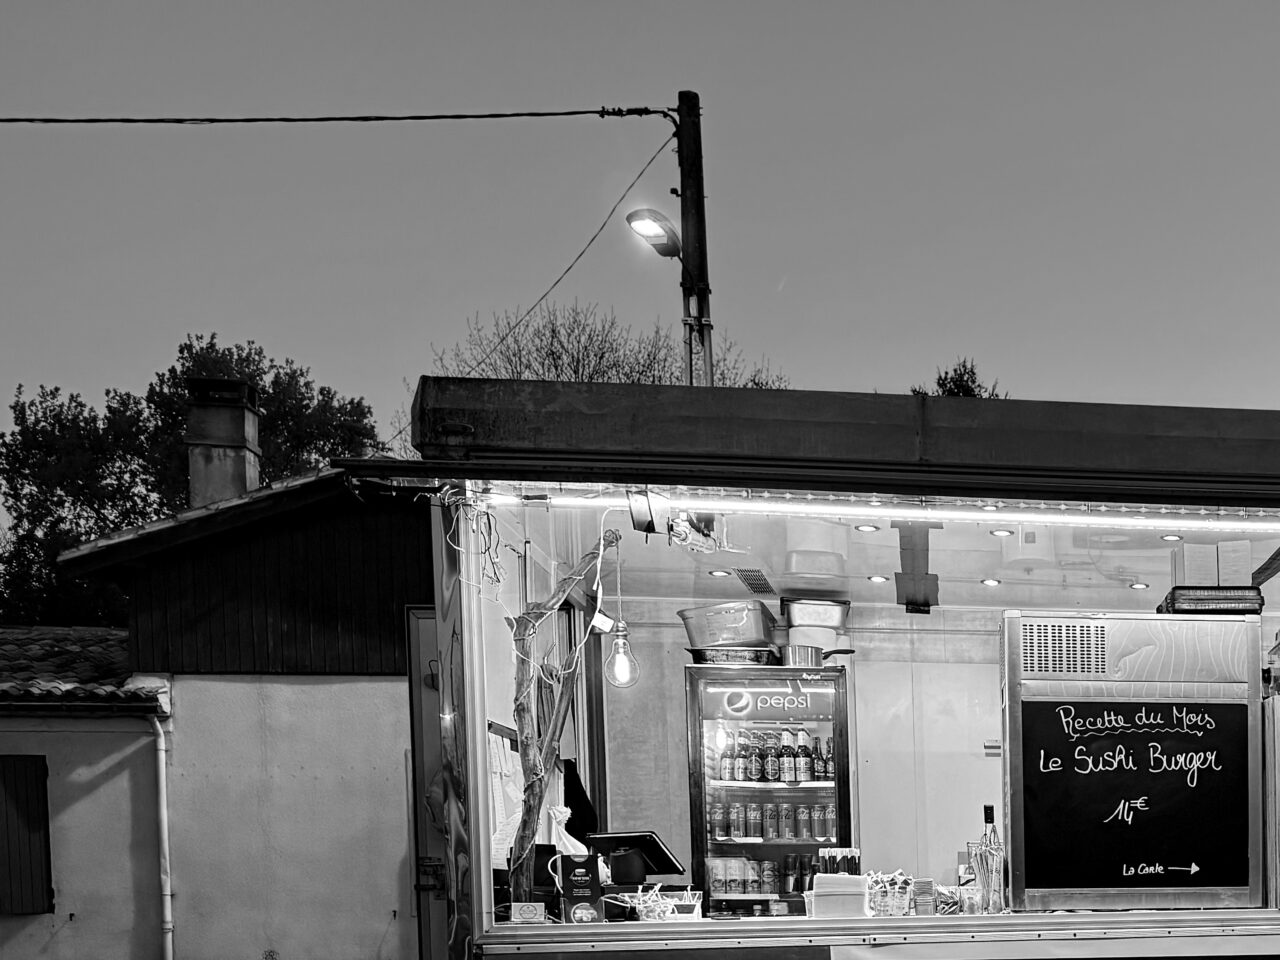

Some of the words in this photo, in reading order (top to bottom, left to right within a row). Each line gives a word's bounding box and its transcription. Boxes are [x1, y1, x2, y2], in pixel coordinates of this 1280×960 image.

[756, 693, 811, 711] pepsi
[1055, 704, 1131, 734] Recette
[1135, 706, 1165, 725] du
[1172, 705, 1216, 731] Mois
[1039, 749, 1063, 773] Le
[1074, 744, 1138, 774] Sushi
[1148, 742, 1223, 788] Burger
[1122, 863, 1135, 876] La
[1137, 862, 1165, 875] Carte
